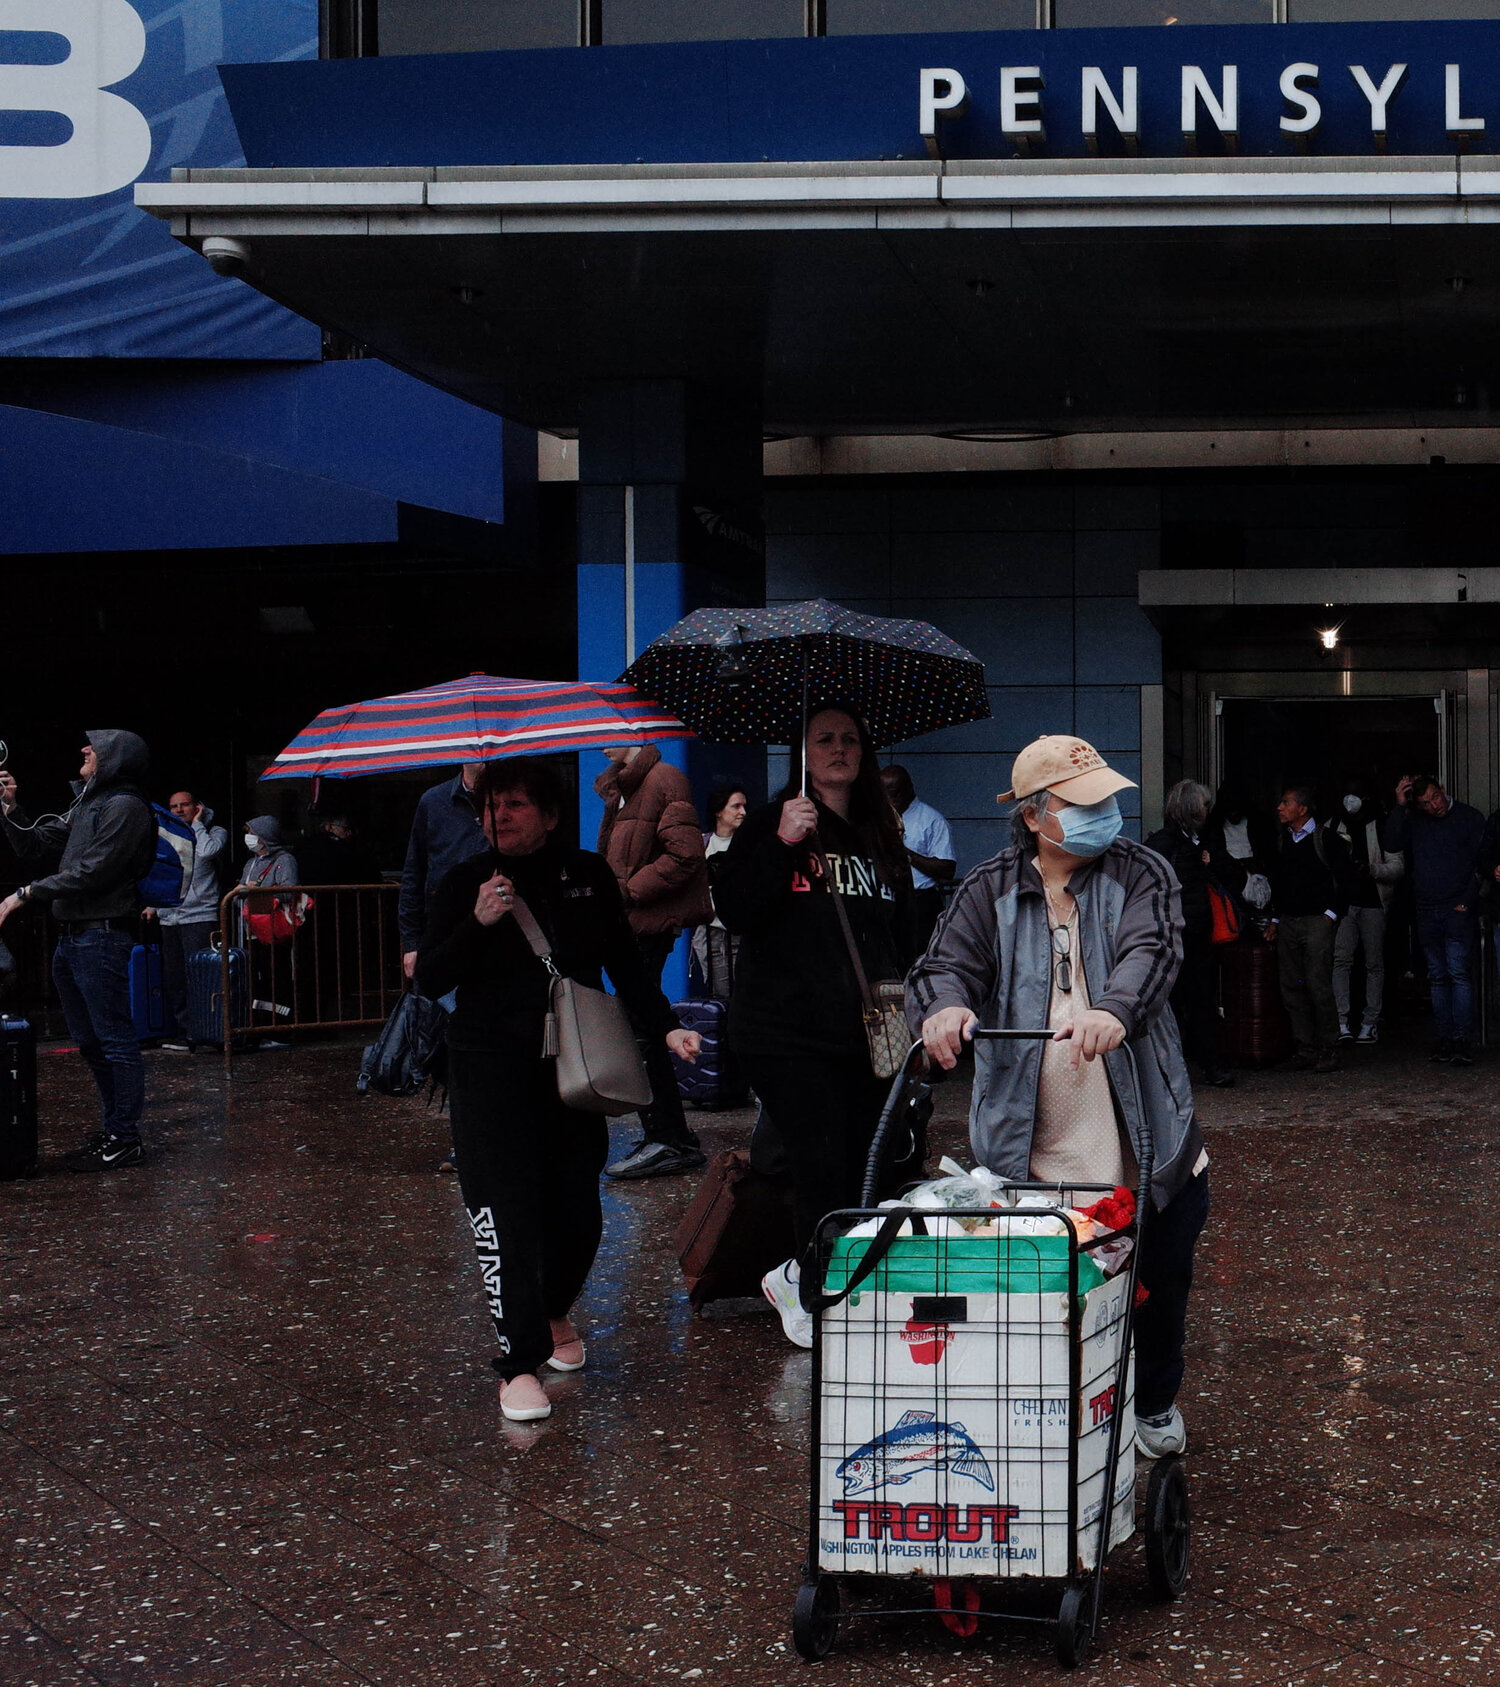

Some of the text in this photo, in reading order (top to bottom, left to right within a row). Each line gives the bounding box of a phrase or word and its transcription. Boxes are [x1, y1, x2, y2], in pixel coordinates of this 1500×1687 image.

[1013, 1399, 1067, 1416] CHELAN
[1014, 1418, 1067, 1427] FRESH
[832, 1499, 1020, 1545] TROUT
[881, 1543, 922, 1558] APPLES
[924, 1545, 956, 1559] FROM
[959, 1546, 990, 1560] LAKE
[992, 1546, 1037, 1561] CHELAN
